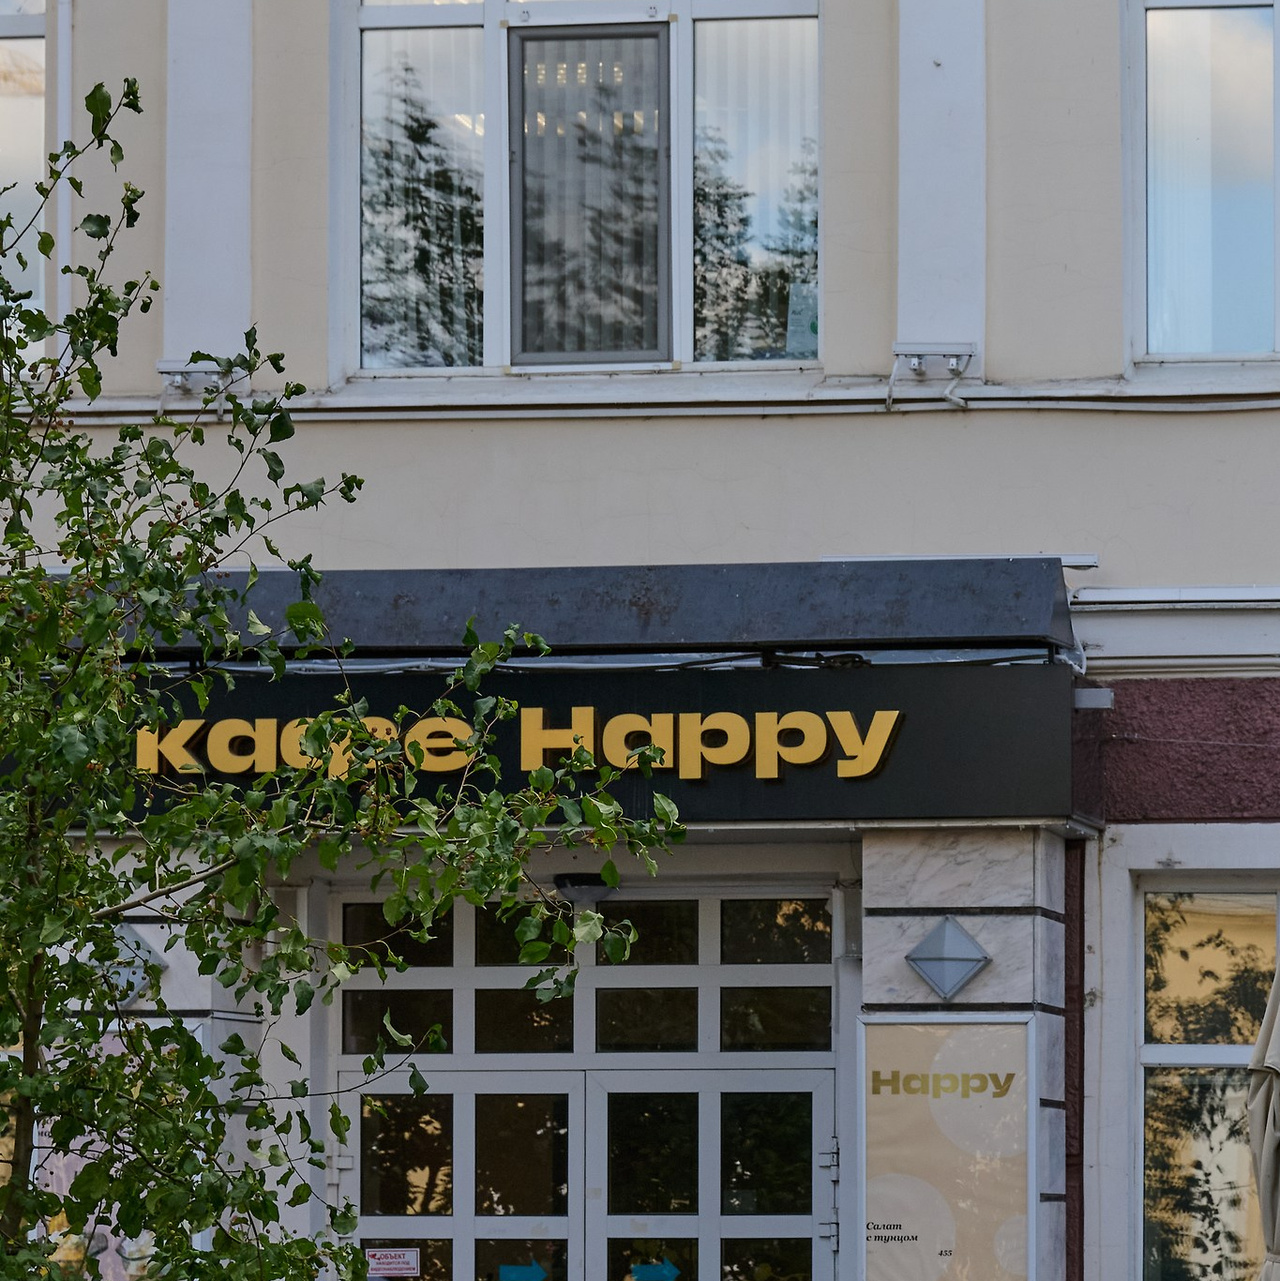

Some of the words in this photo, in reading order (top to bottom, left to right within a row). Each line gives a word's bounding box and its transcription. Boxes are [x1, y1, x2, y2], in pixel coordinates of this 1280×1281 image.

[520, 705, 901, 779] Happy
[871, 1069, 1016, 1099] Happy
[866, 1221, 902, 1231] Салат
[874, 1235, 918, 1244] тунцом
[938, 1249, 953, 1257] 455
